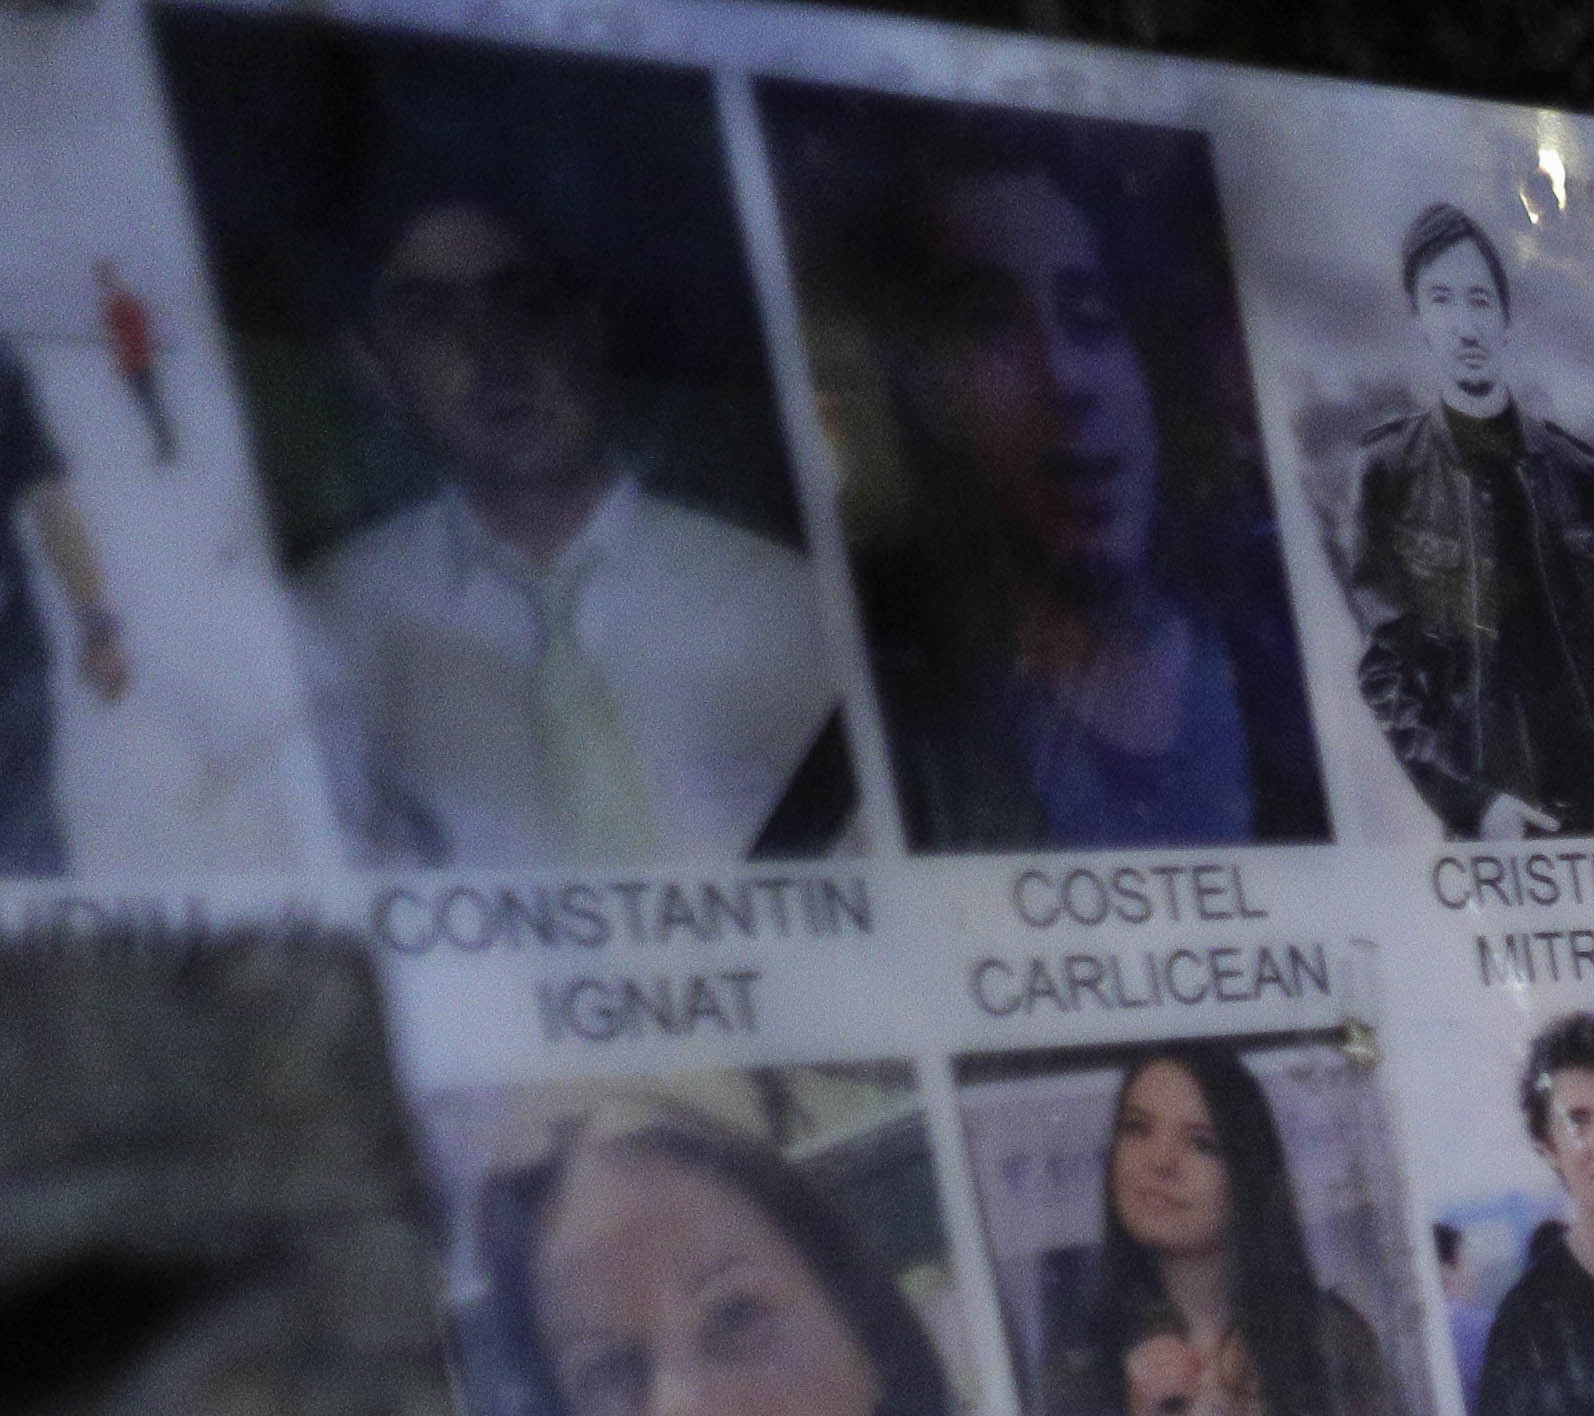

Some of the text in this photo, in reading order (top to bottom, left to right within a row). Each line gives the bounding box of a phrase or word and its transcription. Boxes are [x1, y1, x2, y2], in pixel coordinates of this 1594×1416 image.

[372, 875, 873, 954] CONSTANTIN
[1010, 862, 1268, 932] COSTEL
[540, 970, 762, 1043] IGNAT
[967, 940, 1330, 1020] CARLICEAN
